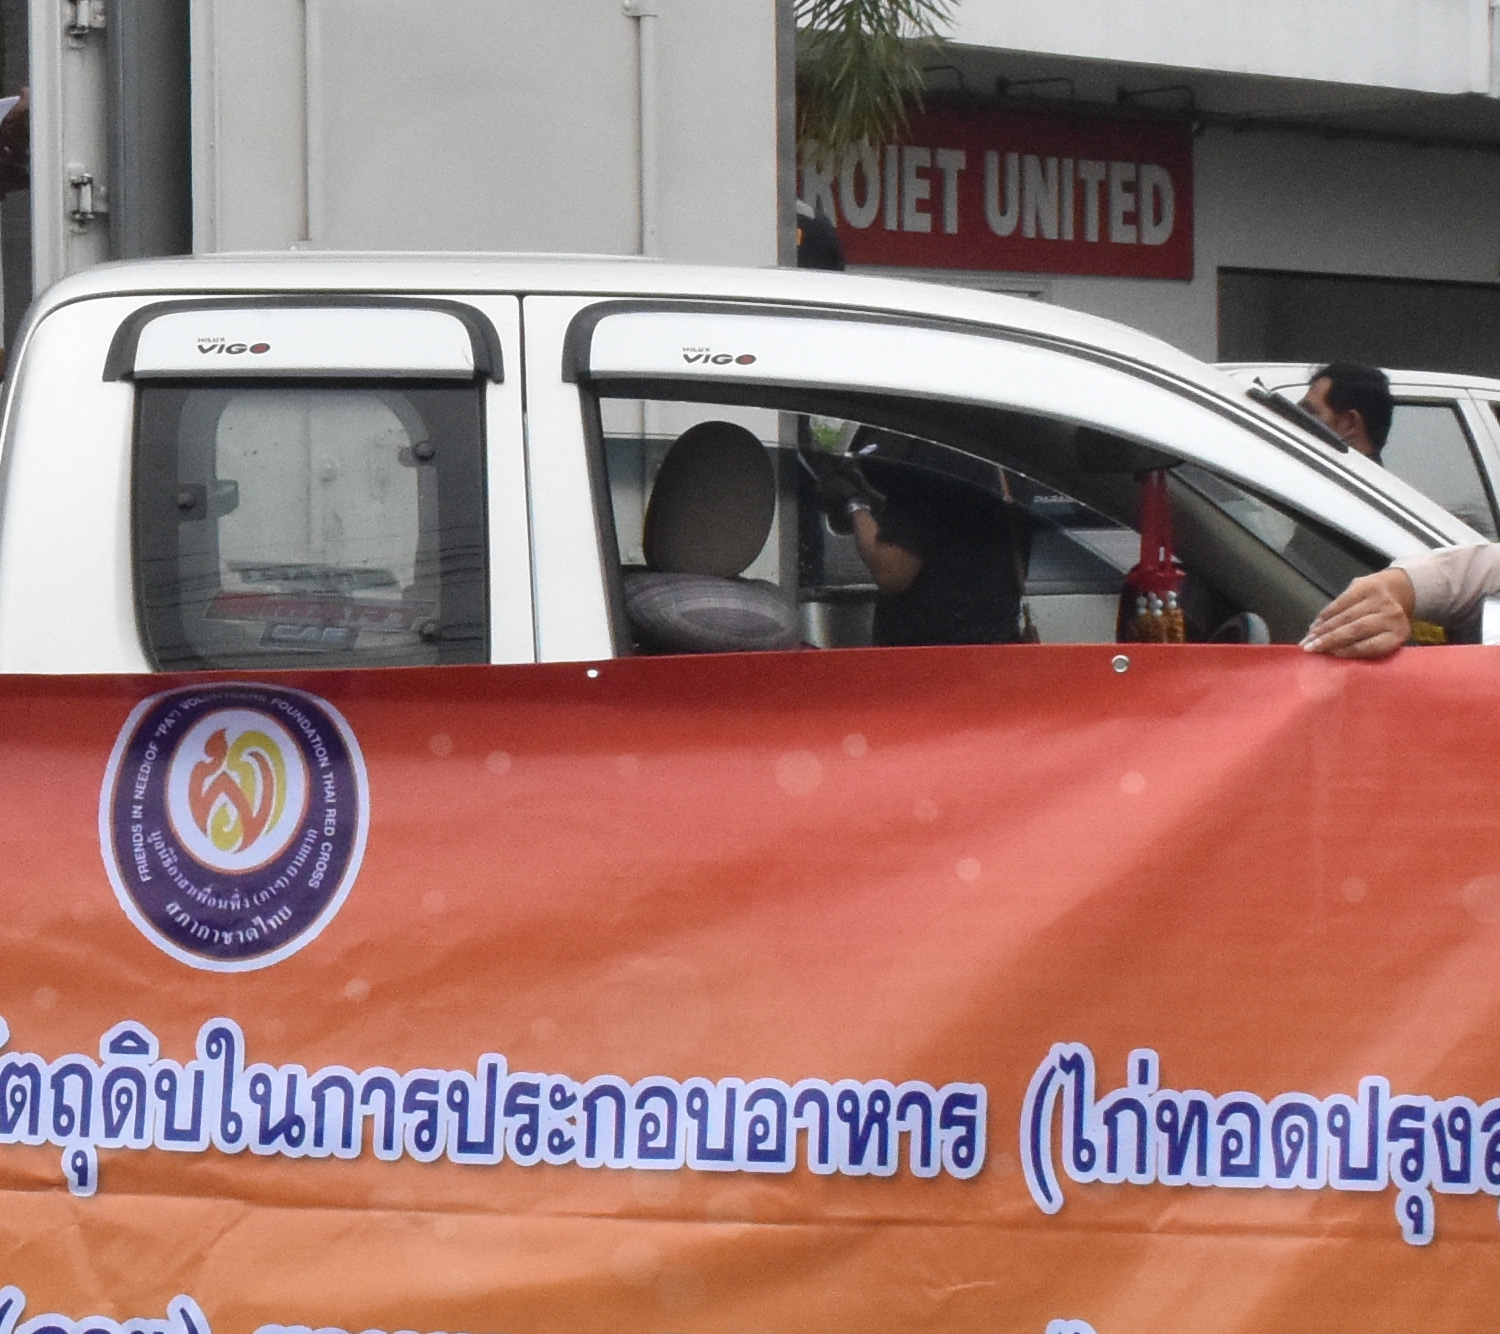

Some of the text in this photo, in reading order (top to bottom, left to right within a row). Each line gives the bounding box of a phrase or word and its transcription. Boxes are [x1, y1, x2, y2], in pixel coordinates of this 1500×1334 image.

[984, 150, 1174, 246] UNITED
[197, 343, 270, 355] VIGO
[682, 354, 757, 365] VIGO
[271, 698, 330, 769] FOUNDATION
[322, 772, 337, 805] THAI
[132, 805, 142, 821] IN
[324, 808, 336, 837] RED
[132, 824, 151, 882] FRIENDS
[308, 842, 333, 889] CROSS
[166, 901, 293, 945] สภากาชาดไทย
